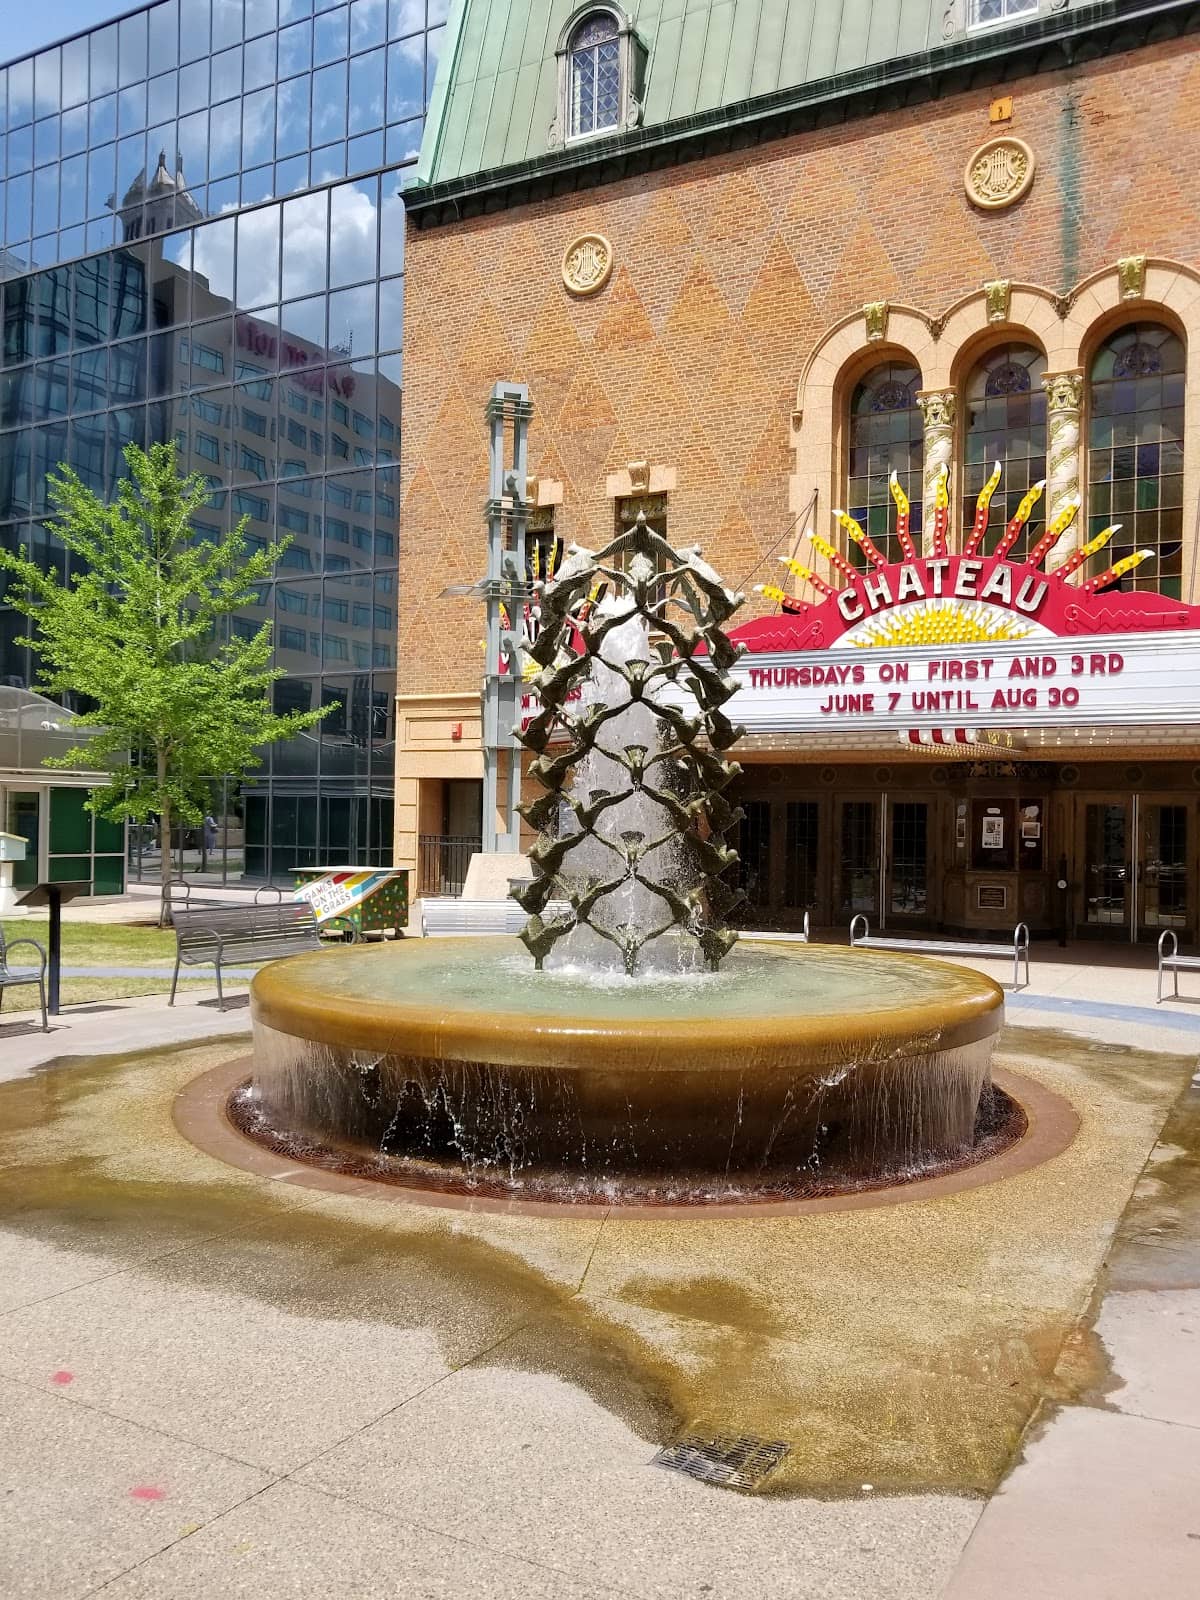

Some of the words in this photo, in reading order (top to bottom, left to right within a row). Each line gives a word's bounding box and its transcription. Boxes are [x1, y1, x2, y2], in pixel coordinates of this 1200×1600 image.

[837, 559, 1048, 620] CHATEAU
[749, 665, 865, 688] THURSDAYS
[879, 663, 909, 683] ON
[928, 660, 993, 681] FIRST
[1008, 656, 1057, 677] AND
[1071, 653, 1124, 675] 3RD
[820, 693, 874, 713] JUNE
[888, 692, 901, 711] 7
[912, 690, 978, 711] UNTIL
[991, 688, 1037, 708] AUG
[1048, 687, 1080, 707] 30
[304, 879, 333, 902] GAMES
[313, 894, 327, 908] ON
[328, 885, 345, 900] THE
[322, 892, 351, 914] GRASS
